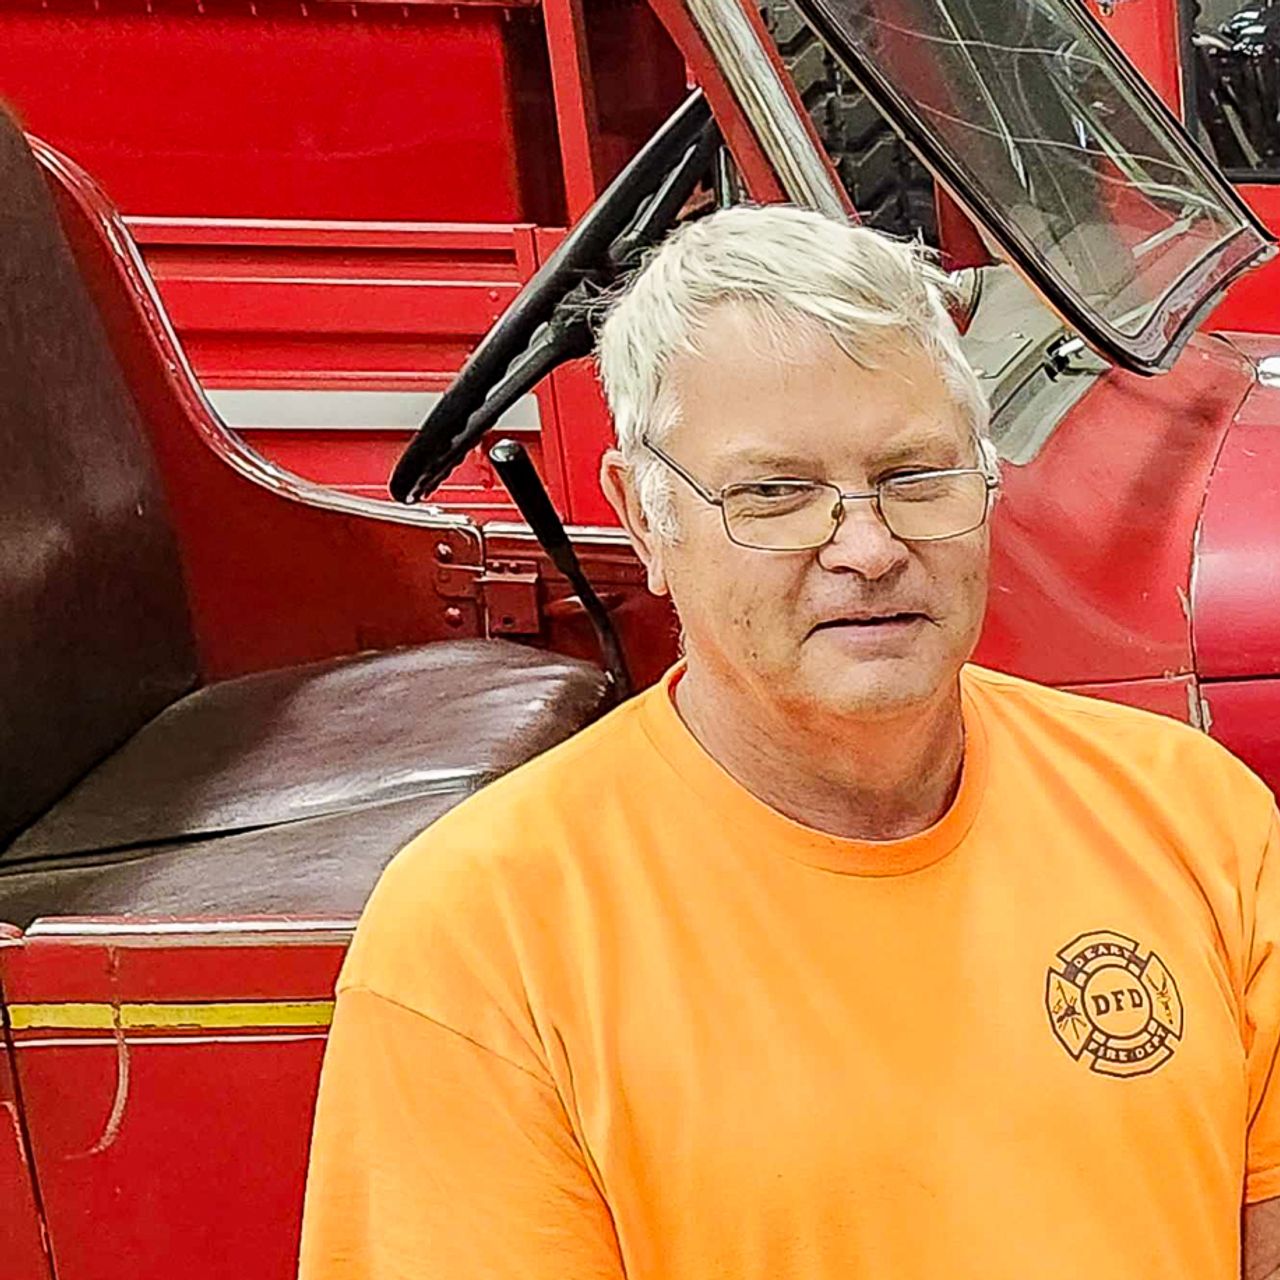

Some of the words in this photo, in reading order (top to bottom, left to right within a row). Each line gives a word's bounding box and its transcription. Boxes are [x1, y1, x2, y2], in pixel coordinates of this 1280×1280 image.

[1073, 945, 1132, 968] DEARY
[1091, 988, 1143, 1016] DFD
[1088, 1041, 1128, 1061] FIRE
[1135, 1027, 1168, 1058] DEPT
